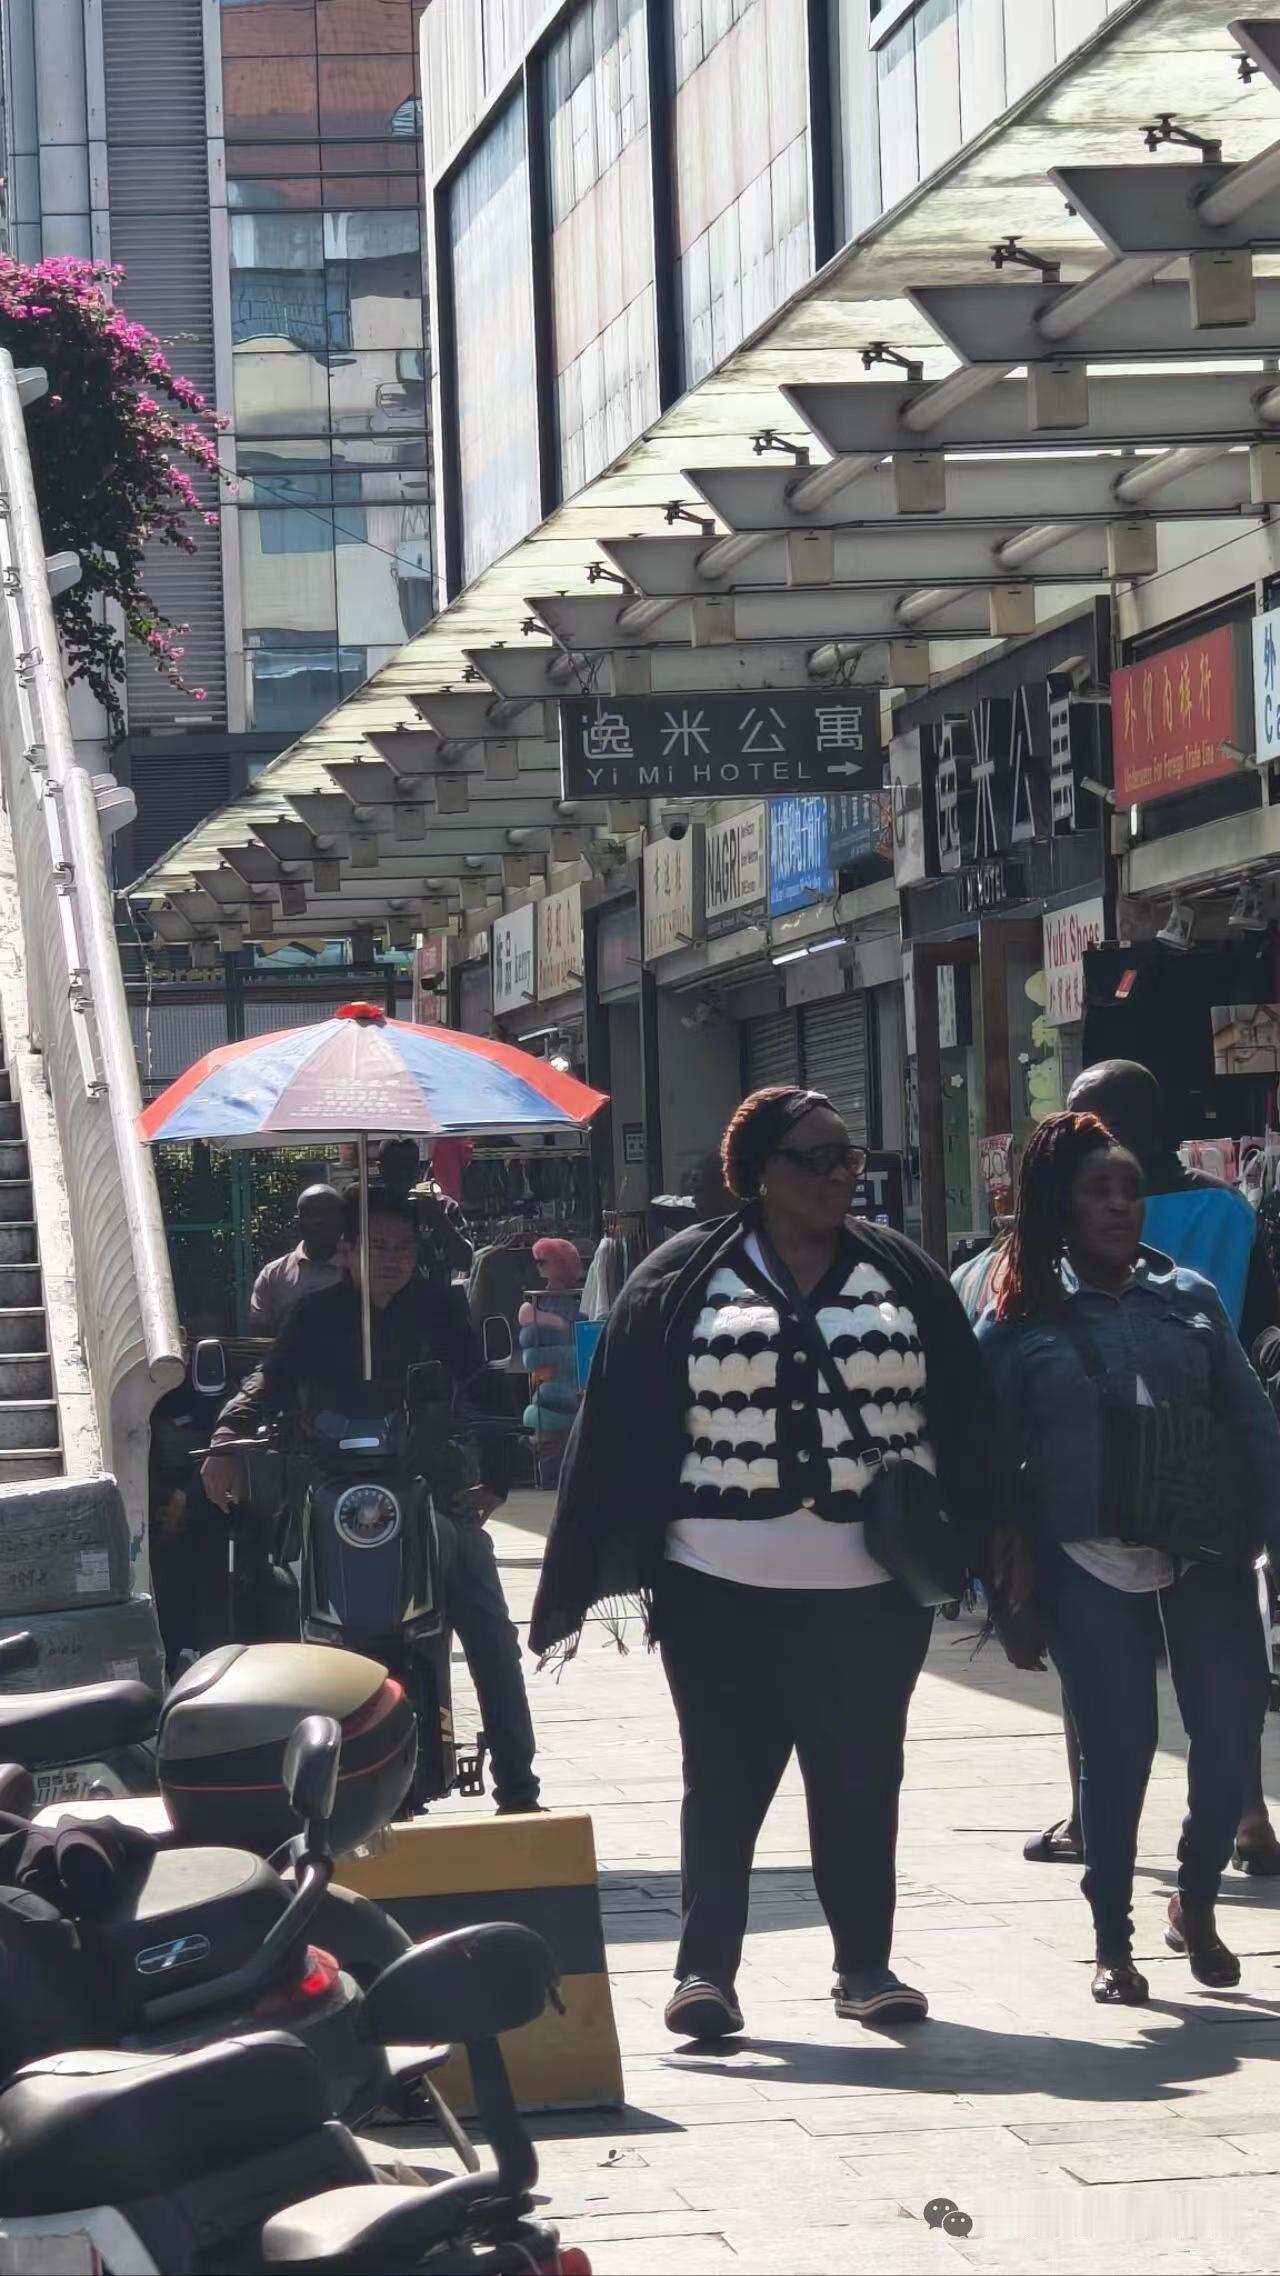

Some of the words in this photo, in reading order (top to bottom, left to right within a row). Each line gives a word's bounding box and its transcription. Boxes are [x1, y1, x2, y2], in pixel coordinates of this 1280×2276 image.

[581, 706, 863, 759] 逸米公寓
[694, 762, 812, 782] HOTEL
[707, 827, 740, 908] NAGRI
[1046, 917, 1068, 968] Yuki
